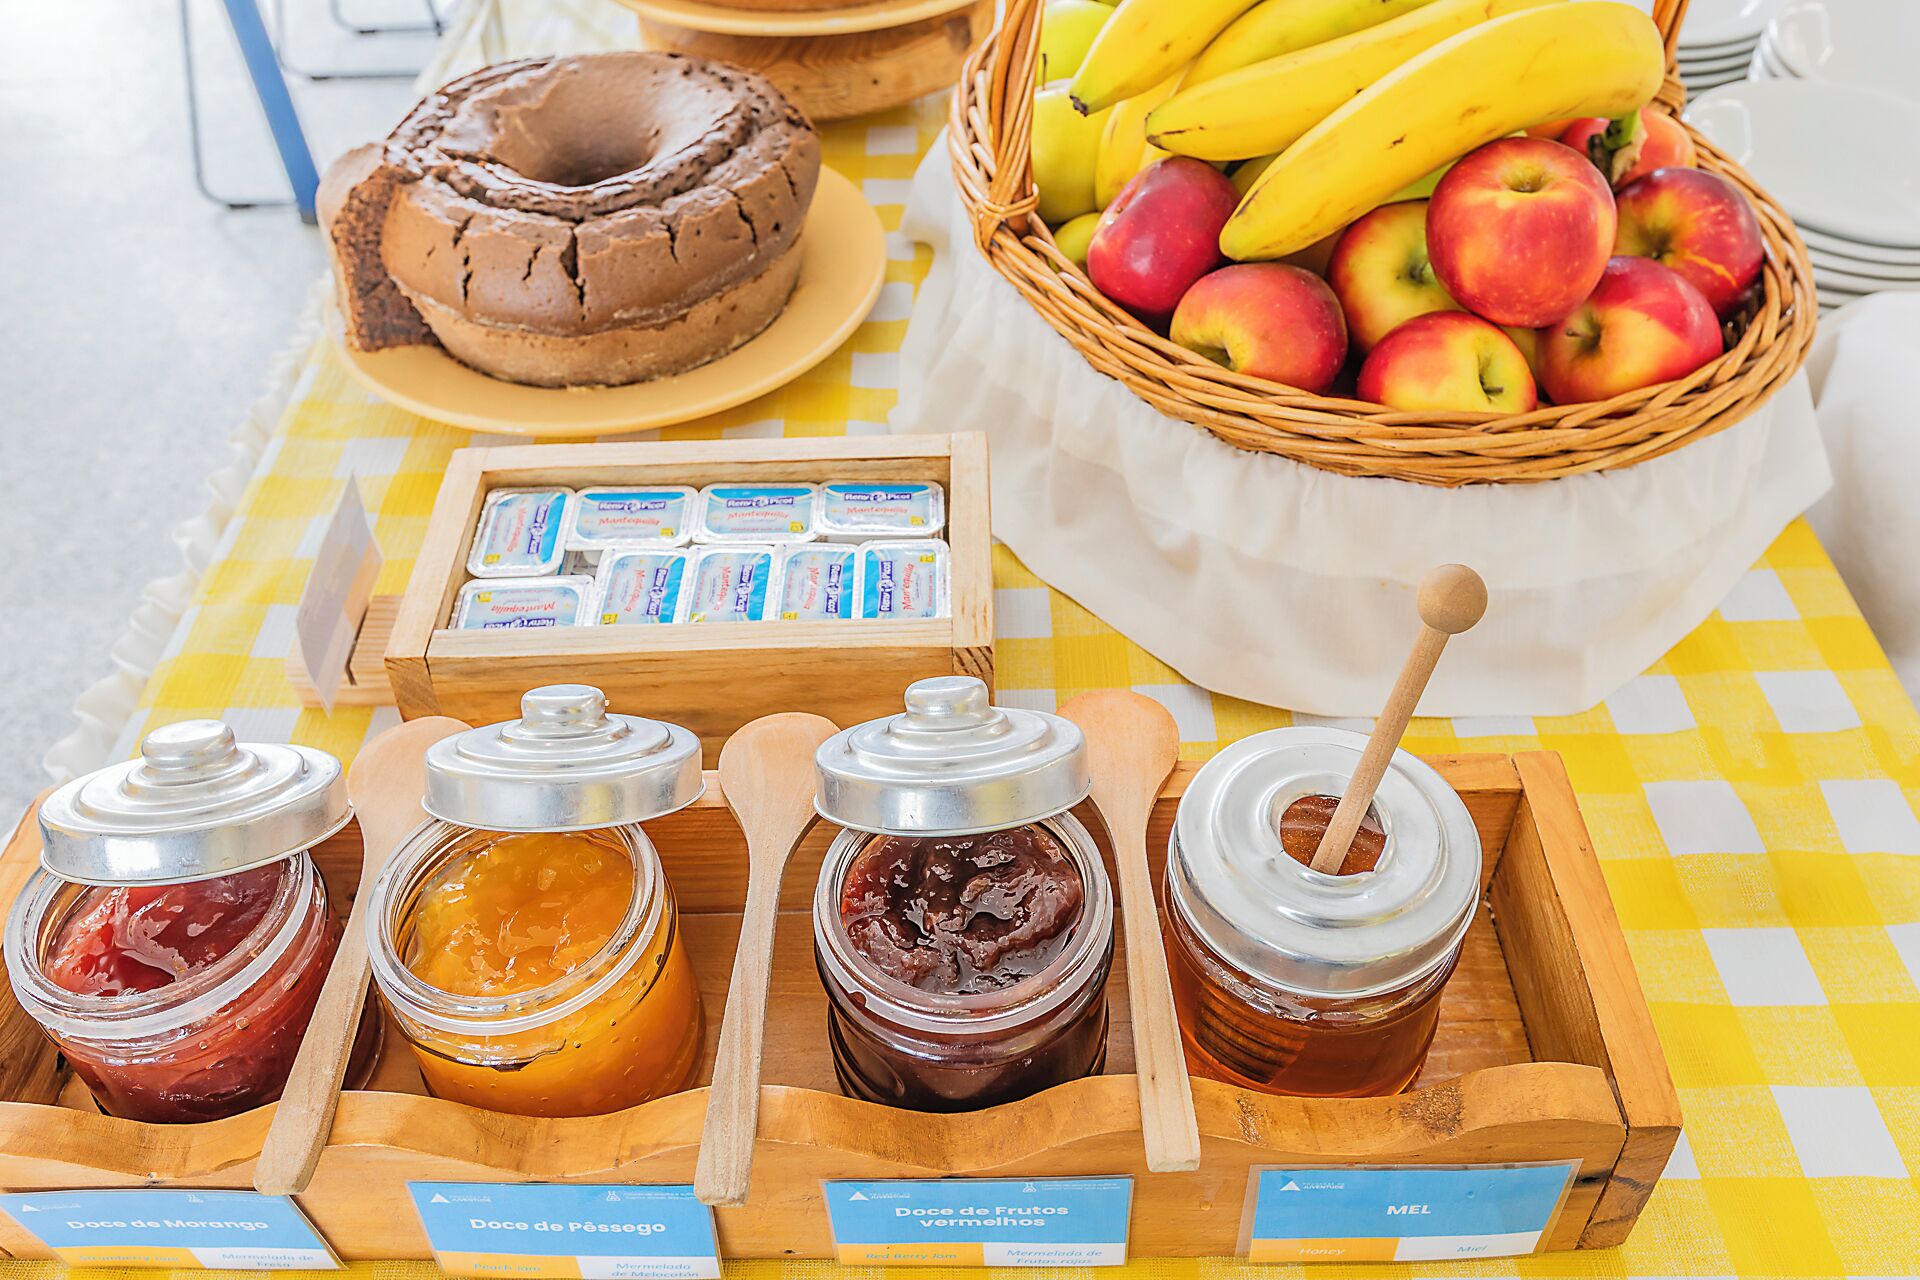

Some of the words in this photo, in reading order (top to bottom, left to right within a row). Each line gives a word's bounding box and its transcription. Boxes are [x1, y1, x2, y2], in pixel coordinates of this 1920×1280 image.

[895, 1207, 954, 1217] Doce
[959, 1206, 990, 1217] de
[996, 1206, 1069, 1216] Frutos
[1386, 1204, 1432, 1216] MEL
[66, 1219, 123, 1230] Doce
[131, 1218, 162, 1229] de
[163, 1218, 269, 1232] Morango
[469, 1217, 529, 1231] Doce
[533, 1220, 564, 1232] de
[568, 1220, 667, 1236] Pêssego
[919, 1216, 1046, 1228] vermelhos
[1007, 1249, 1082, 1257] Mermelada
[1086, 1249, 1103, 1257] de
[1299, 1247, 1345, 1257] Honey
[1456, 1245, 1489, 1254] Miel
[616, 1262, 692, 1271] Mermelada
[611, 1270, 627, 1278] de
